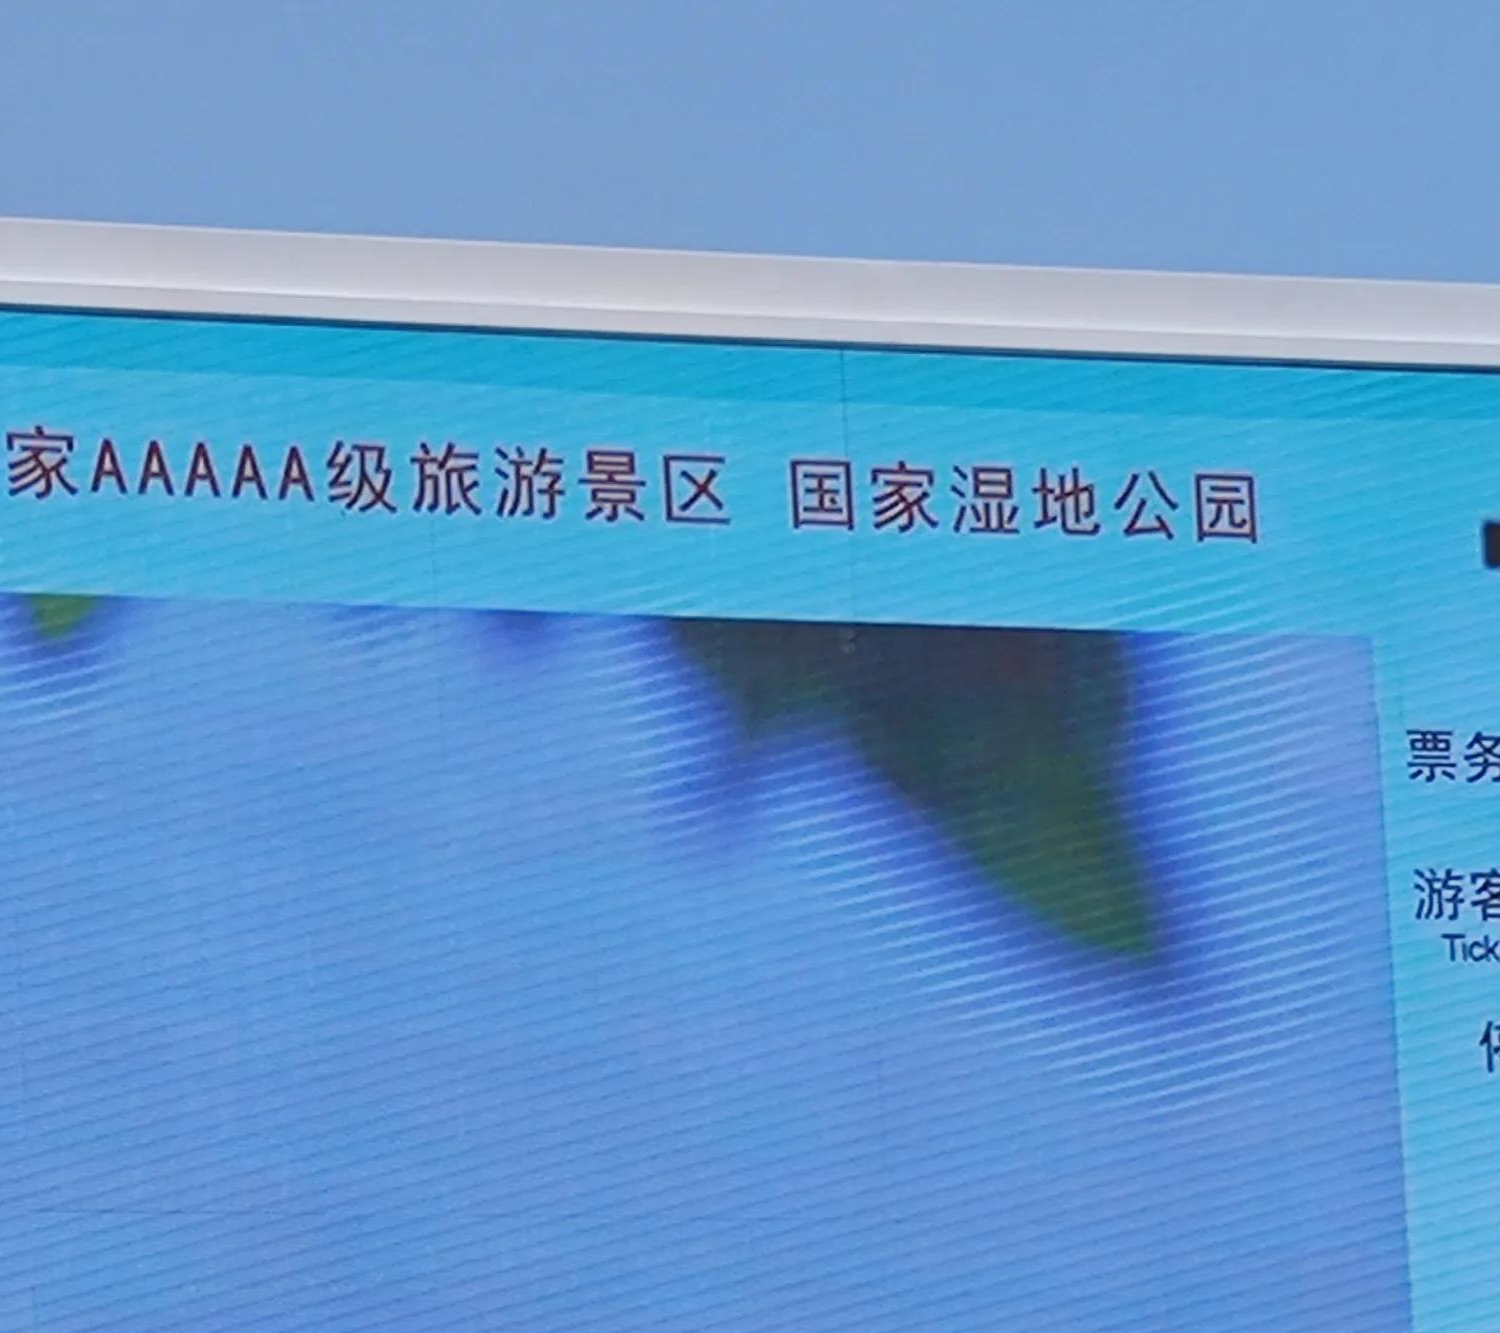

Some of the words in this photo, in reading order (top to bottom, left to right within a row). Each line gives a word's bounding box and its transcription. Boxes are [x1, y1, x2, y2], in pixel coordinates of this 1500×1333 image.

[789, 458, 1259, 544] 国家湿地公园
